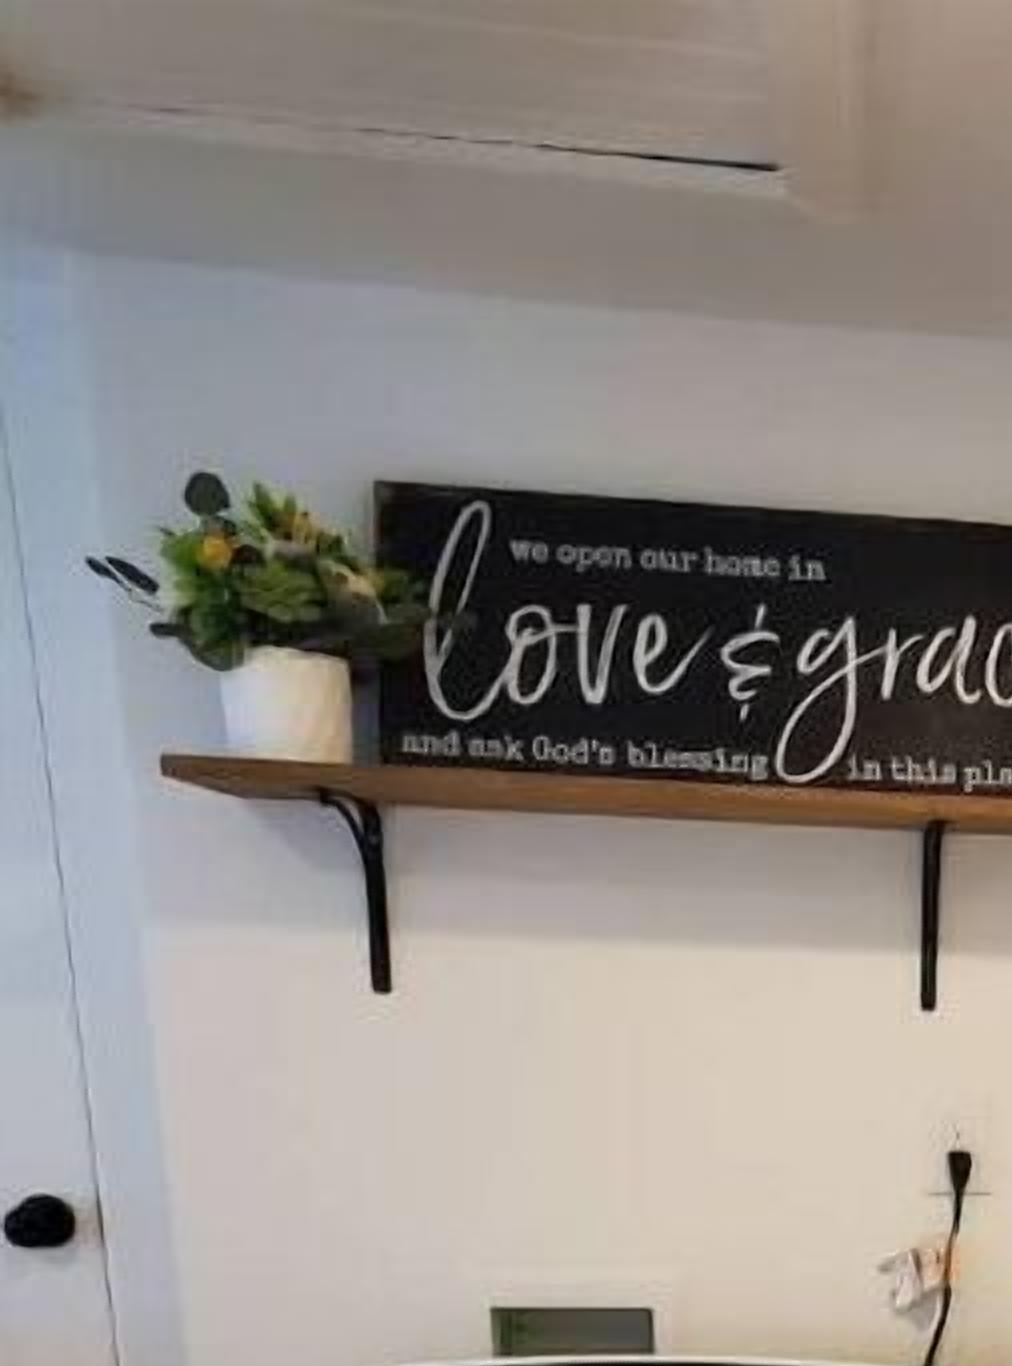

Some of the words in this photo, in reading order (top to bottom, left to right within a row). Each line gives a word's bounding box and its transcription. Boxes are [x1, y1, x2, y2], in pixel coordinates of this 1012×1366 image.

[509, 539, 548, 564] we
[555, 544, 632, 573] open
[639, 547, 698, 573] our
[703, 546, 781, 577] home
[788, 554, 826, 581] in
[423, 500, 706, 720] love
[719, 604, 780, 721] &
[402, 731, 461, 757] and
[466, 735, 525, 762] ask
[532, 735, 616, 766] God's
[628, 740, 768, 781] blessing
[847, 754, 882, 781] in
[891, 754, 956, 785] this
